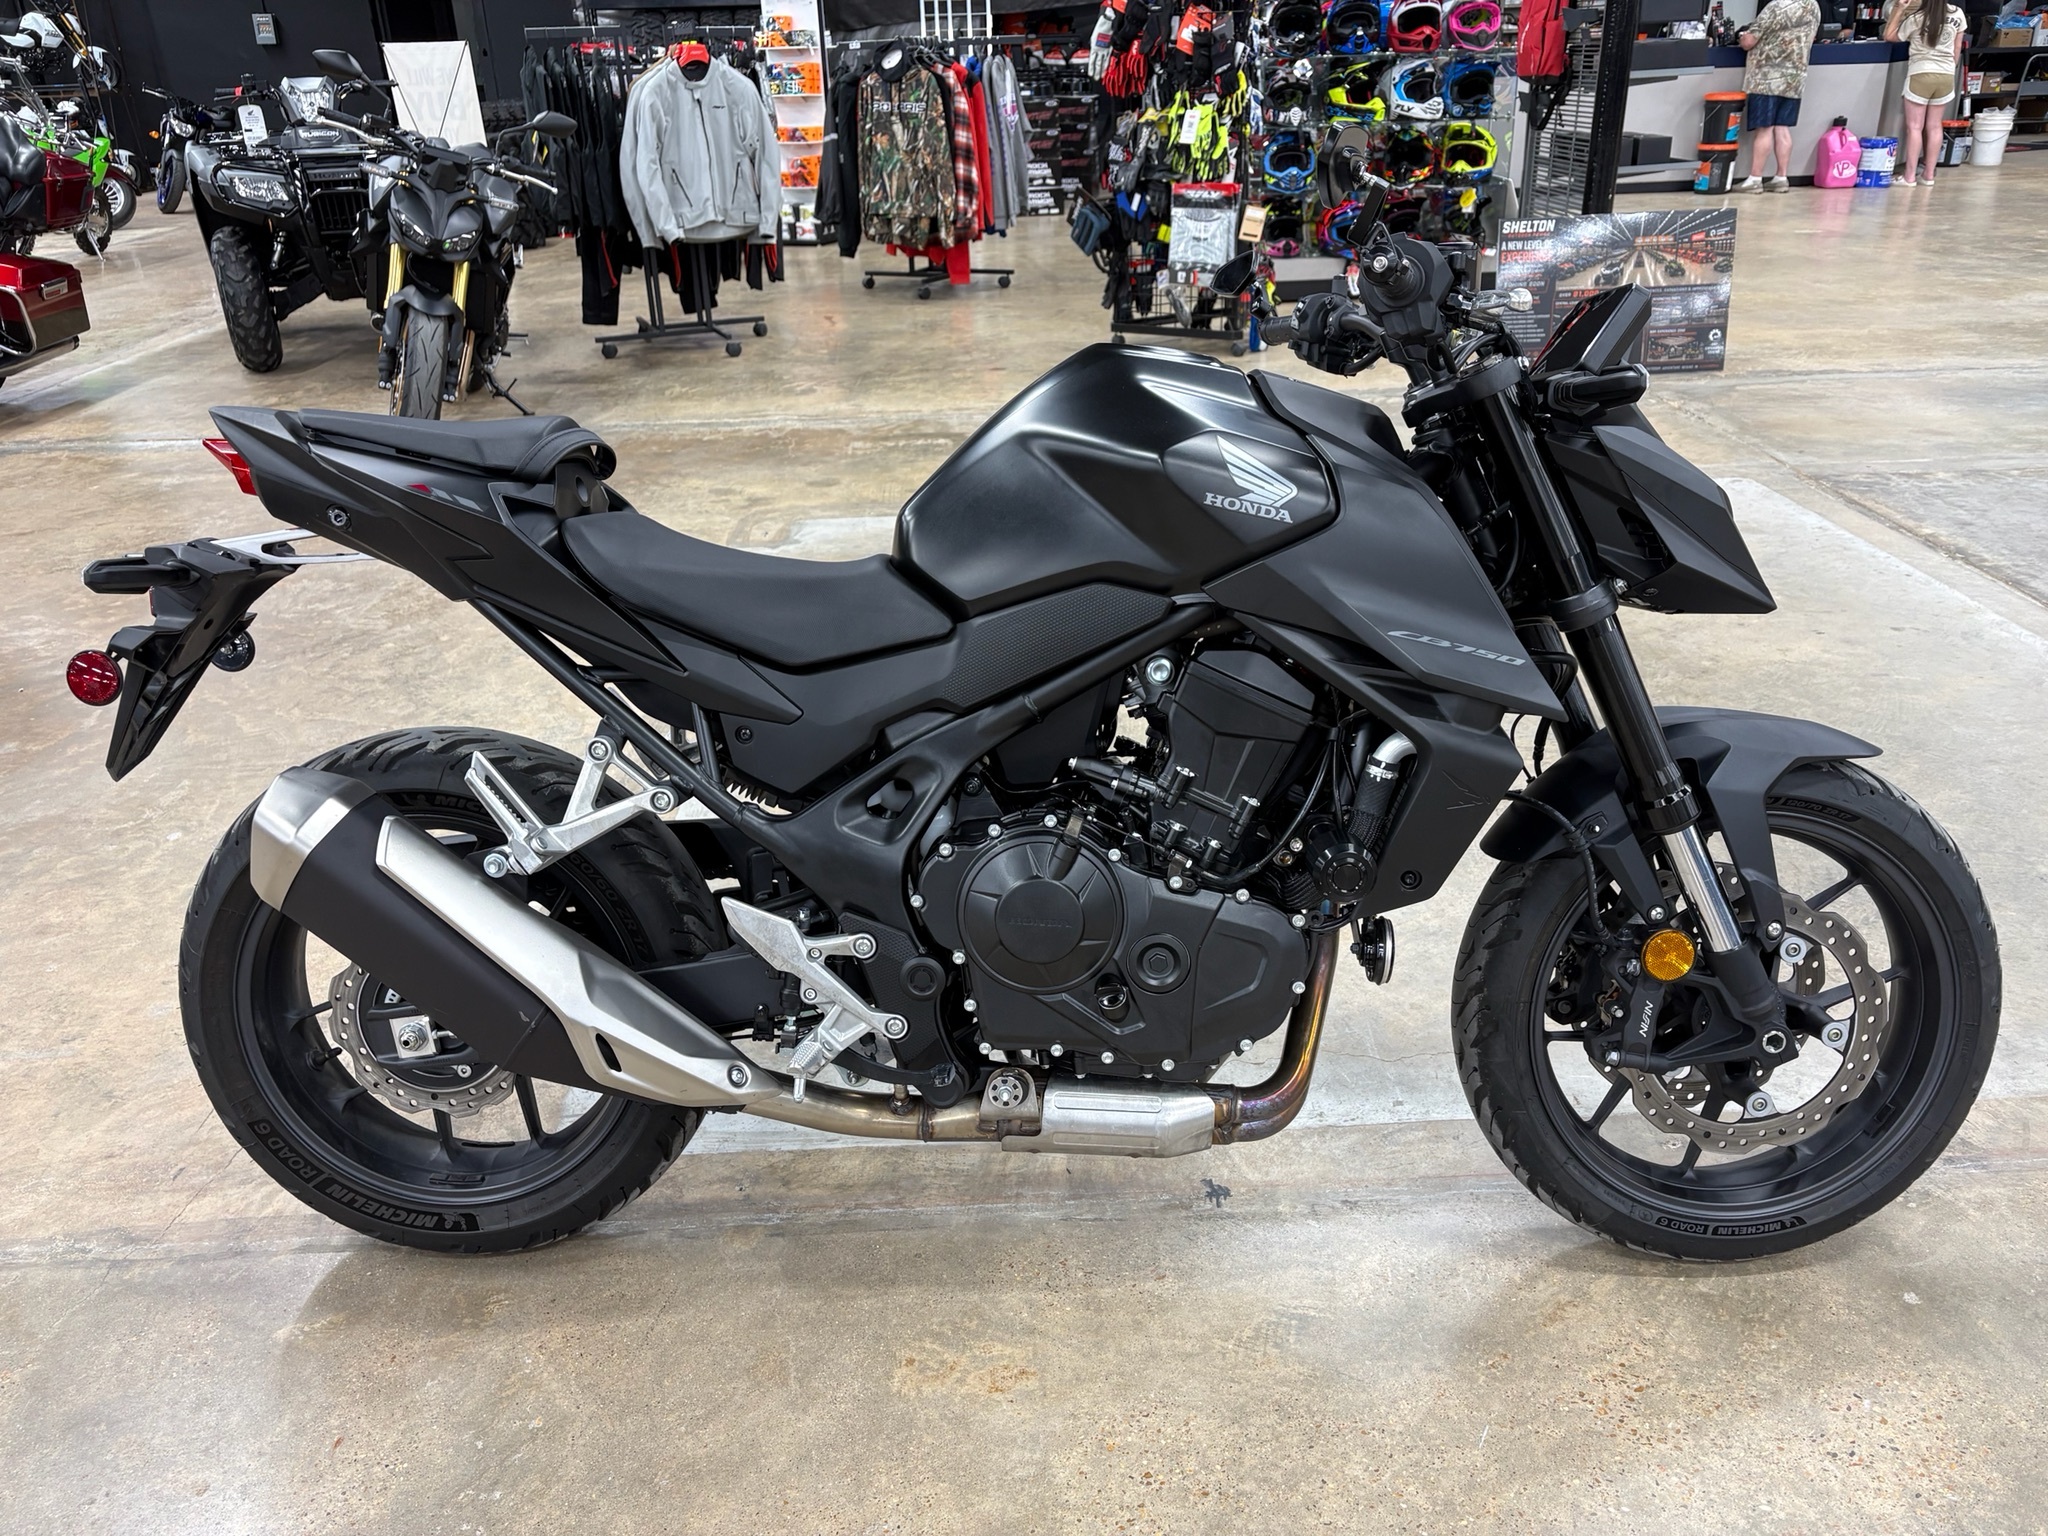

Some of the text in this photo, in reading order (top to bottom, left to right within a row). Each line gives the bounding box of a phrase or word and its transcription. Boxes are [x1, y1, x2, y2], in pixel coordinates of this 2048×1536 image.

[1395, 103, 1416, 113] FLY
[1834, 160, 1850, 177] VP
[1502, 219, 1556, 234] SHELTON
[1508, 241, 1523, 250] NEW
[1524, 239, 1542, 249] LEVEL
[1203, 492, 1293, 524] HONDA
[1387, 630, 1526, 666] CB750
[1008, 917, 1073, 929] HONDA
[254, 1123, 438, 1229] MICHELIN ROAD 6
[1660, 1218, 1782, 1236] MICHELIN ROAD 6
